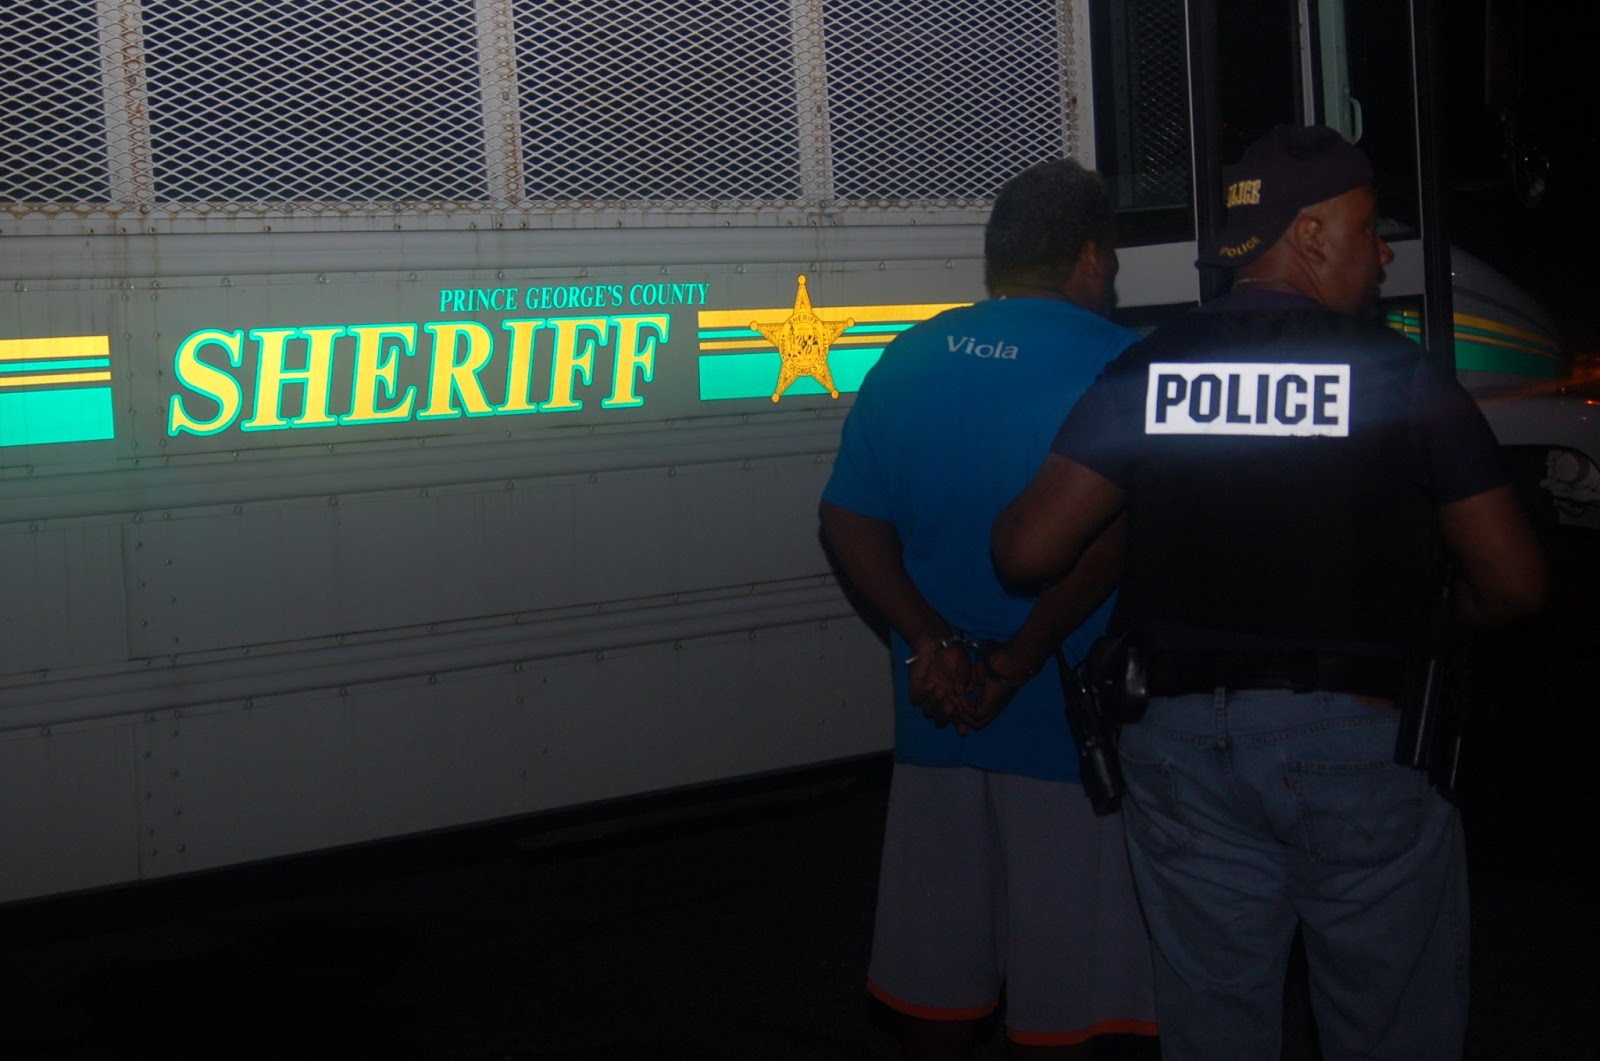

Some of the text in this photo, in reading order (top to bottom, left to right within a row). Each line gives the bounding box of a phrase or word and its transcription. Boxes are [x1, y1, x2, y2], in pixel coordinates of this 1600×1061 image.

[1220, 236, 1262, 257] POLICE
[439, 282, 711, 313] PRINCE GEORGE'S COUNTY
[788, 314, 818, 325] SHERIFF
[946, 335, 1020, 360] Viola
[166, 312, 672, 438] SHERIFF
[1155, 373, 1340, 425] POLICE
